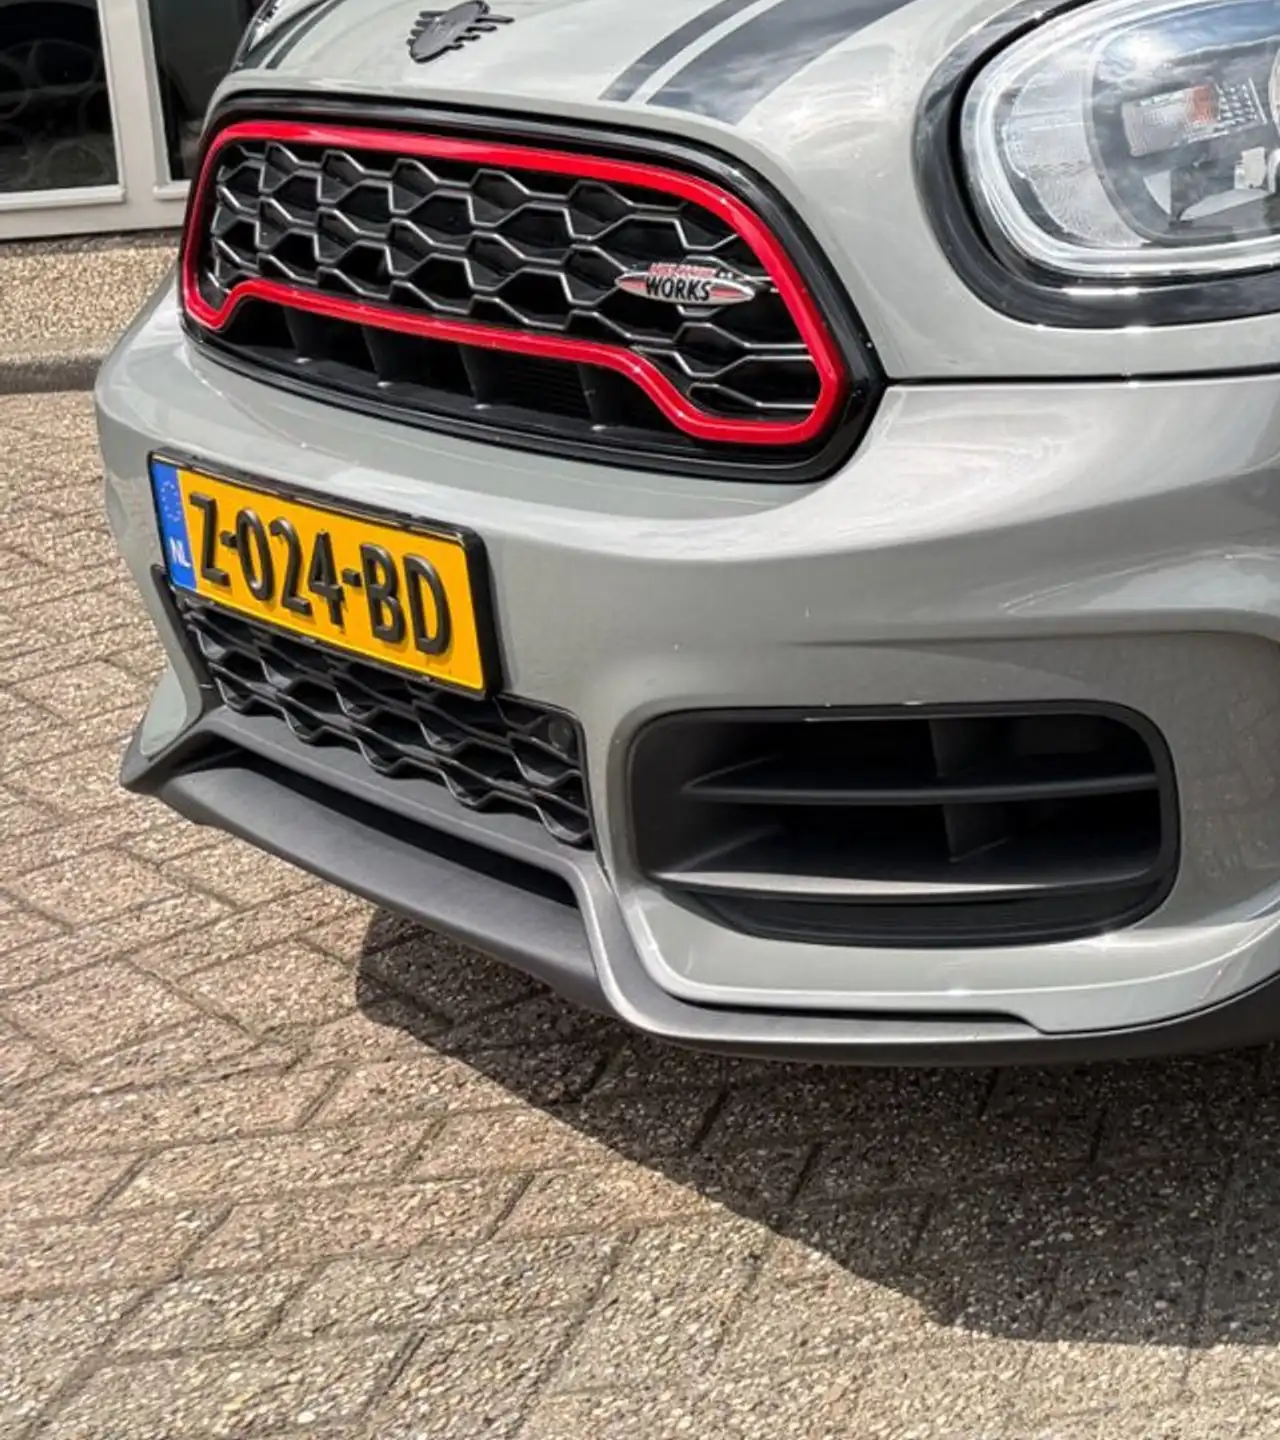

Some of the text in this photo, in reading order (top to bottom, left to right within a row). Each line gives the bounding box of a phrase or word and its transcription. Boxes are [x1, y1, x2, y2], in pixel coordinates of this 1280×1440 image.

[644, 276, 712, 301] WORKS
[168, 490, 452, 656] NL Z-024-BD
